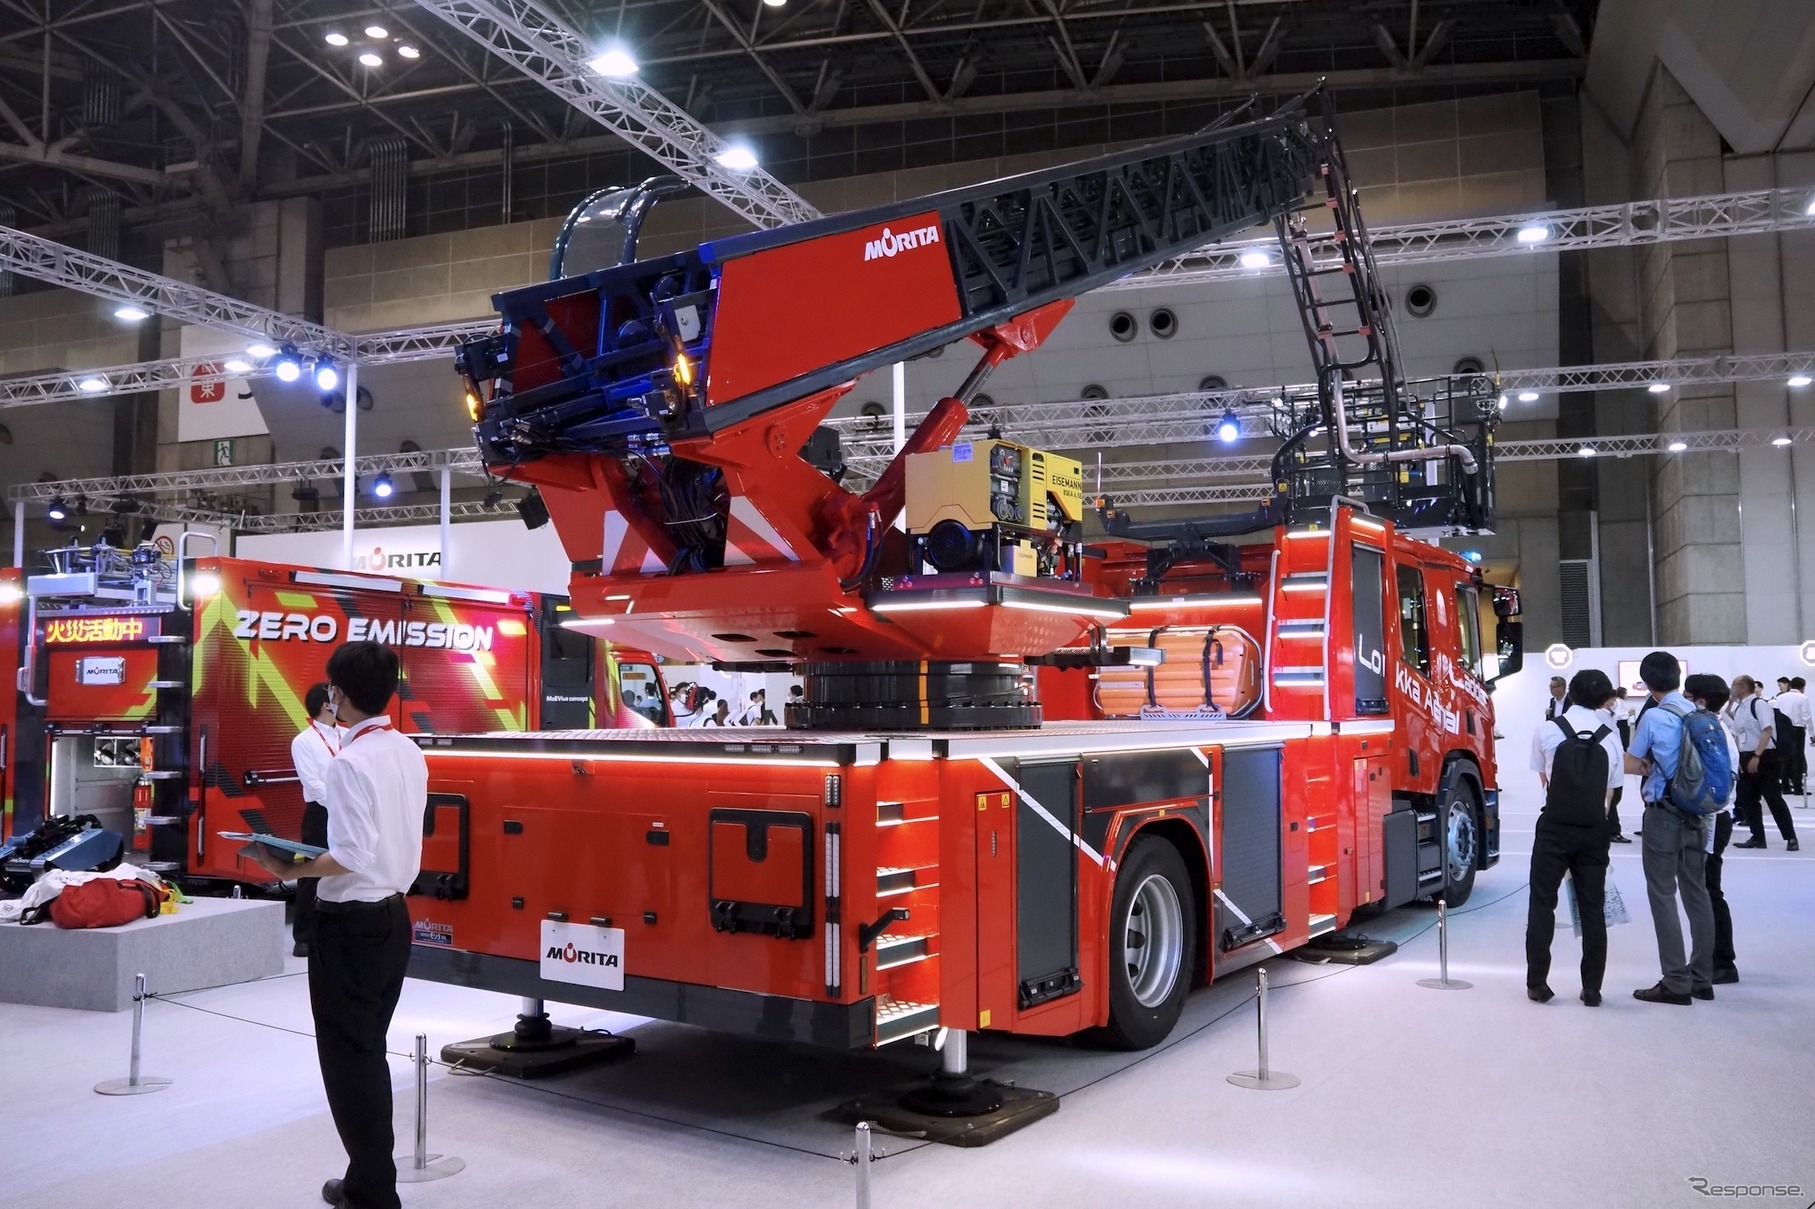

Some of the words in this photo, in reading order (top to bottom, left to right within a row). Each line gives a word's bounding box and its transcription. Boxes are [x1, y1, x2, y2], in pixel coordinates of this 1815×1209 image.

[864, 225, 940, 262] MORITA
[1052, 474, 1082, 490] EISEMANN
[351, 546, 442, 571] MORITA
[45, 617, 143, 643] 火災活動中
[233, 609, 338, 642] ZERO
[346, 618, 494, 651] EMISSION
[86, 667, 118, 675] MORITA
[414, 917, 453, 933] MORITA
[546, 942, 618, 968] MORITA
